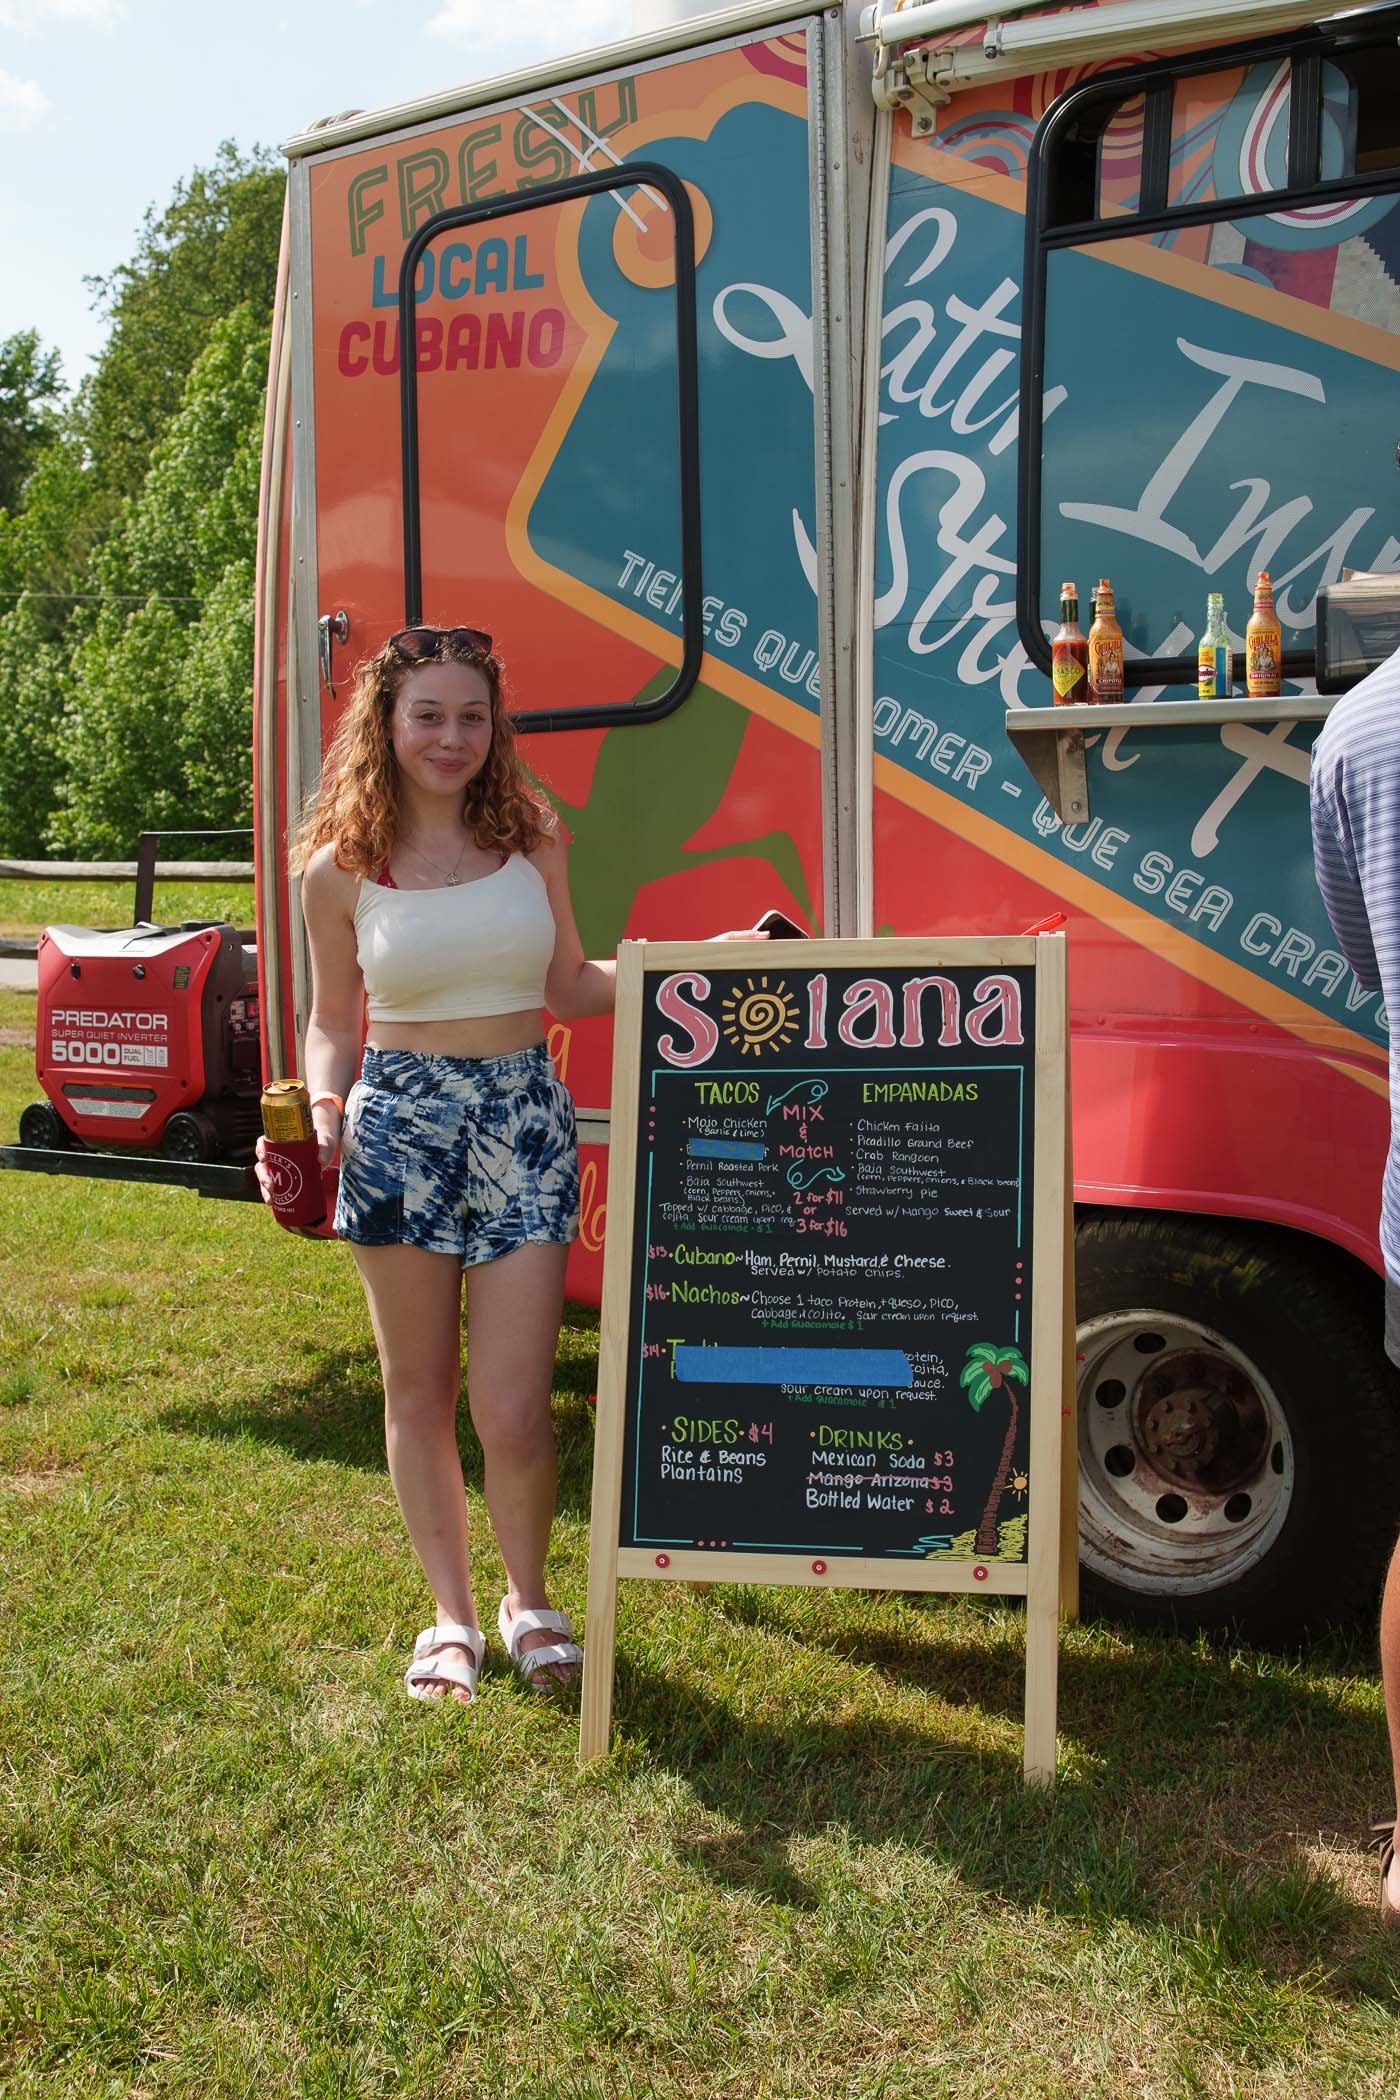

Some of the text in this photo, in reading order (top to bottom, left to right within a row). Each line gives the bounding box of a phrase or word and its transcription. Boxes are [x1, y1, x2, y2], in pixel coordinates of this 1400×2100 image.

[371, 235, 545, 309] LOCAL
[338, 308, 565, 377] CUBANO
[1133, 851, 1234, 932] SEA
[51, 1010, 168, 1030] PREDATOR
[51, 1029, 168, 1042] SUPER QUIET INVERTER
[51, 1040, 120, 1065] 5000
[694, 1081, 760, 1105] TACOS
[863, 1081, 979, 1103] EMPANADAS
[783, 1104, 825, 1121] MIX
[687, 1115, 768, 1130] Mojo Chicken
[857, 1118, 900, 1132] Chicken
[857, 1134, 975, 1150] Picadillo Ground Beef
[855, 1148, 940, 1164] Crab Rangoon
[686, 1160, 780, 1173] Pernil Roasted Pork
[857, 1163, 947, 1179] Baja Southwest
[686, 1175, 765, 1188] Baja Southwest
[967, 1177, 994, 1186] Black
[793, 1191, 803, 1205] 2
[806, 1192, 825, 1204] for
[825, 1187, 844, 1205] $11
[855, 1185, 914, 1200] Strawberry
[721, 1213, 750, 1224] cream
[803, 1207, 817, 1215] or
[845, 1206, 882, 1217] Served
[886, 1207, 899, 1218] w/
[902, 1207, 939, 1220] Mango
[944, 1208, 974, 1218] Sweet
[984, 1208, 1012, 1218] Sour
[796, 1217, 848, 1238] 3 for $16
[674, 1243, 736, 1266] Cubano
[894, 1254, 951, 1269] Cheese.
[751, 1265, 795, 1277] Served
[816, 1268, 857, 1278] Potato
[671, 1280, 740, 1305] Nachos
[751, 1290, 792, 1305] Choose
[797, 1294, 804, 1306] 1
[808, 1294, 833, 1306] taco
[856, 1310, 878, 1321] Sour
[881, 1311, 911, 1321] cream
[913, 1312, 935, 1322] upon
[814, 1385, 853, 1397] cream
[858, 1388, 889, 1400] upon
[896, 1390, 937, 1401] request.
[672, 1416, 773, 1445] SIDES $4
[819, 1425, 903, 1451] DRINKS
[662, 1445, 766, 1467] Rice & Beans
[812, 1449, 954, 1469] Mexican Soda $3
[661, 1463, 743, 1483] Plantains
[806, 1471, 864, 1489] Mango
[870, 1473, 929, 1489] Arizona
[806, 1488, 861, 1509] Bottled
[867, 1493, 915, 1512] Water
